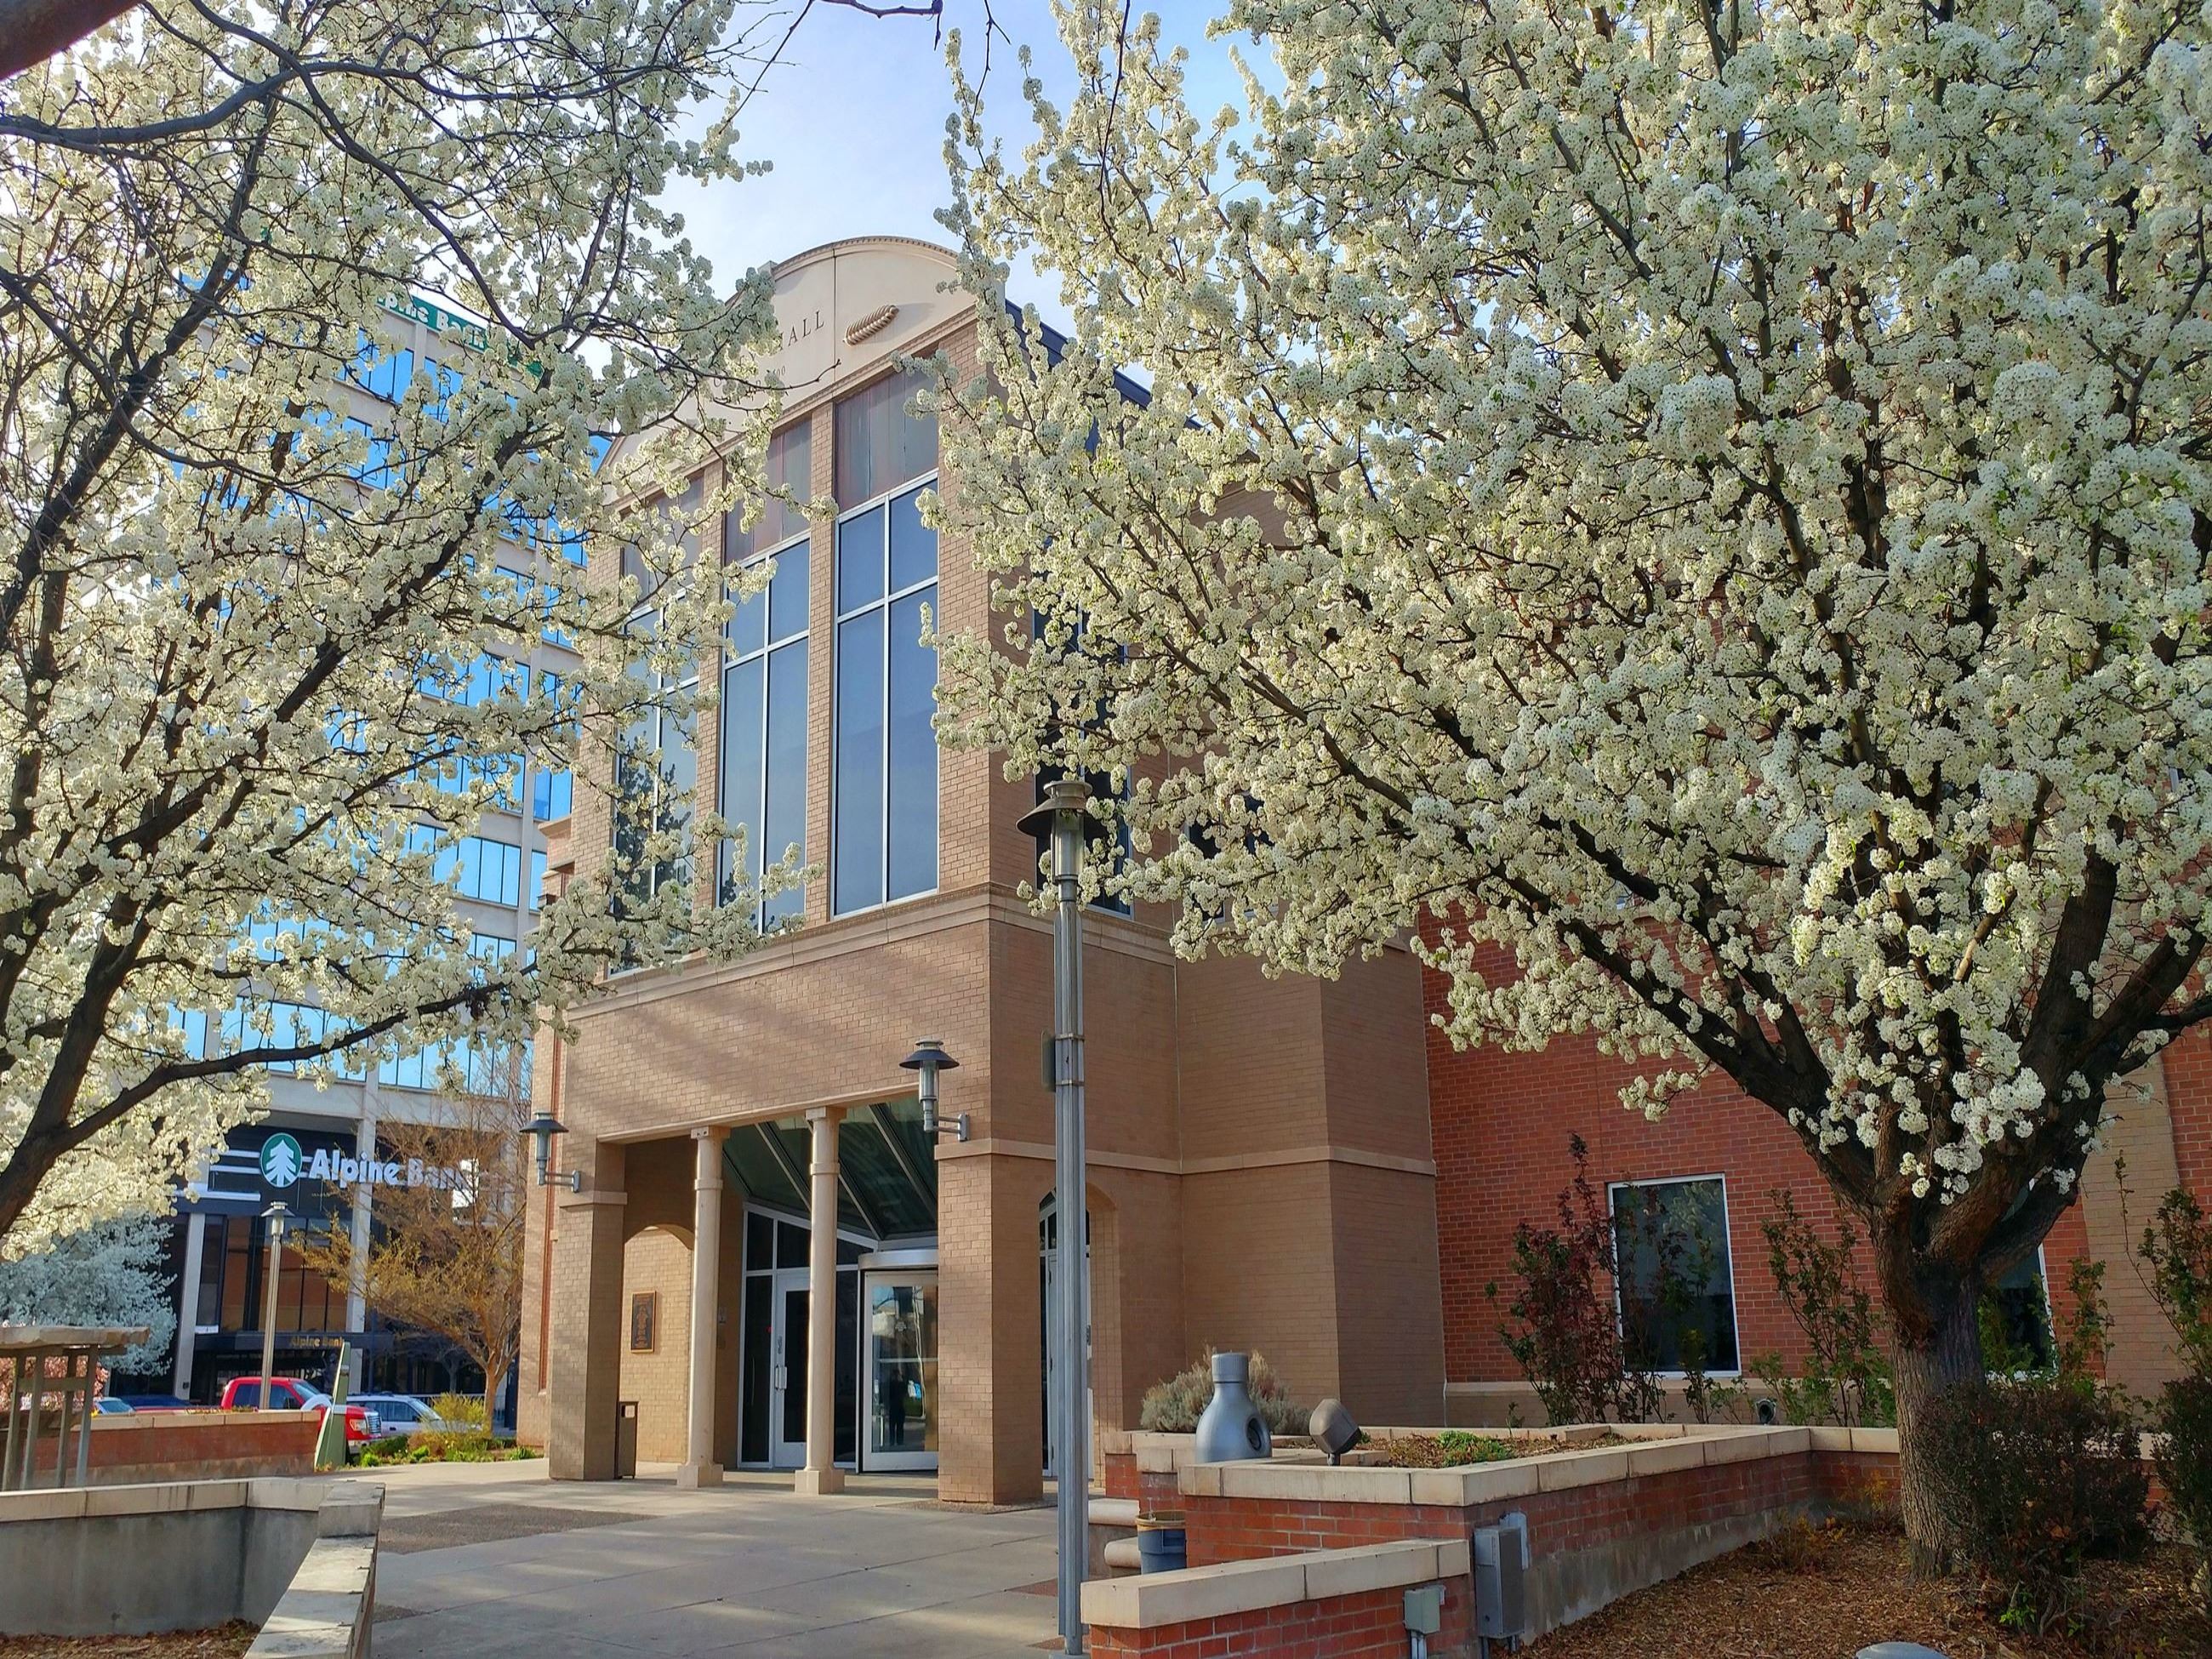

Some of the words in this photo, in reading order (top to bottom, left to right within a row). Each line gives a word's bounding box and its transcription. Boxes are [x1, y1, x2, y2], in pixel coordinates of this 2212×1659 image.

[378, 292, 429, 322] pne
[778, 310, 824, 351] ALL
[309, 1149, 400, 1188] Alpine
